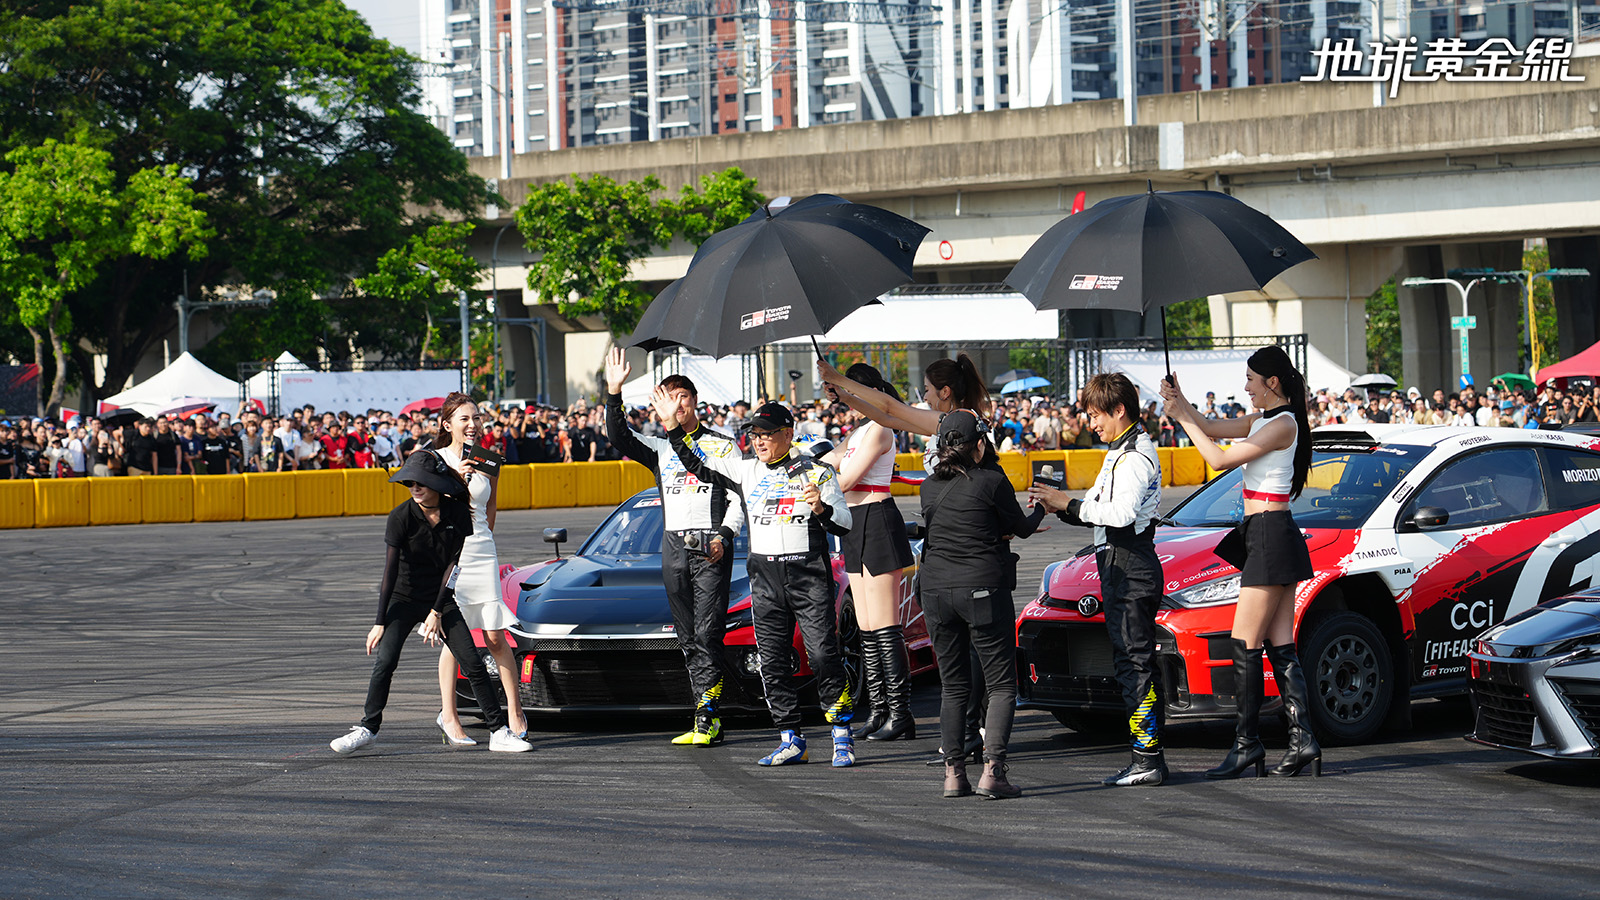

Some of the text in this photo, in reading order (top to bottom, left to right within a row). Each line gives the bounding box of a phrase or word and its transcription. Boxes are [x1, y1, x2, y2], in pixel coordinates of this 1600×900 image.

[1459, 434, 1492, 446] PROTERIAL
[673, 473, 699, 485] GR
[1562, 468, 1598, 482] MORIZO
[763, 501, 794, 515] GR
[1355, 547, 1398, 559] TAMADIC
[1394, 567, 1411, 575] PIAA
[1294, 572, 1331, 612] AUTOMOTIVE
[1451, 599, 1493, 630] CCi
[1422, 666, 1438, 677] GR
